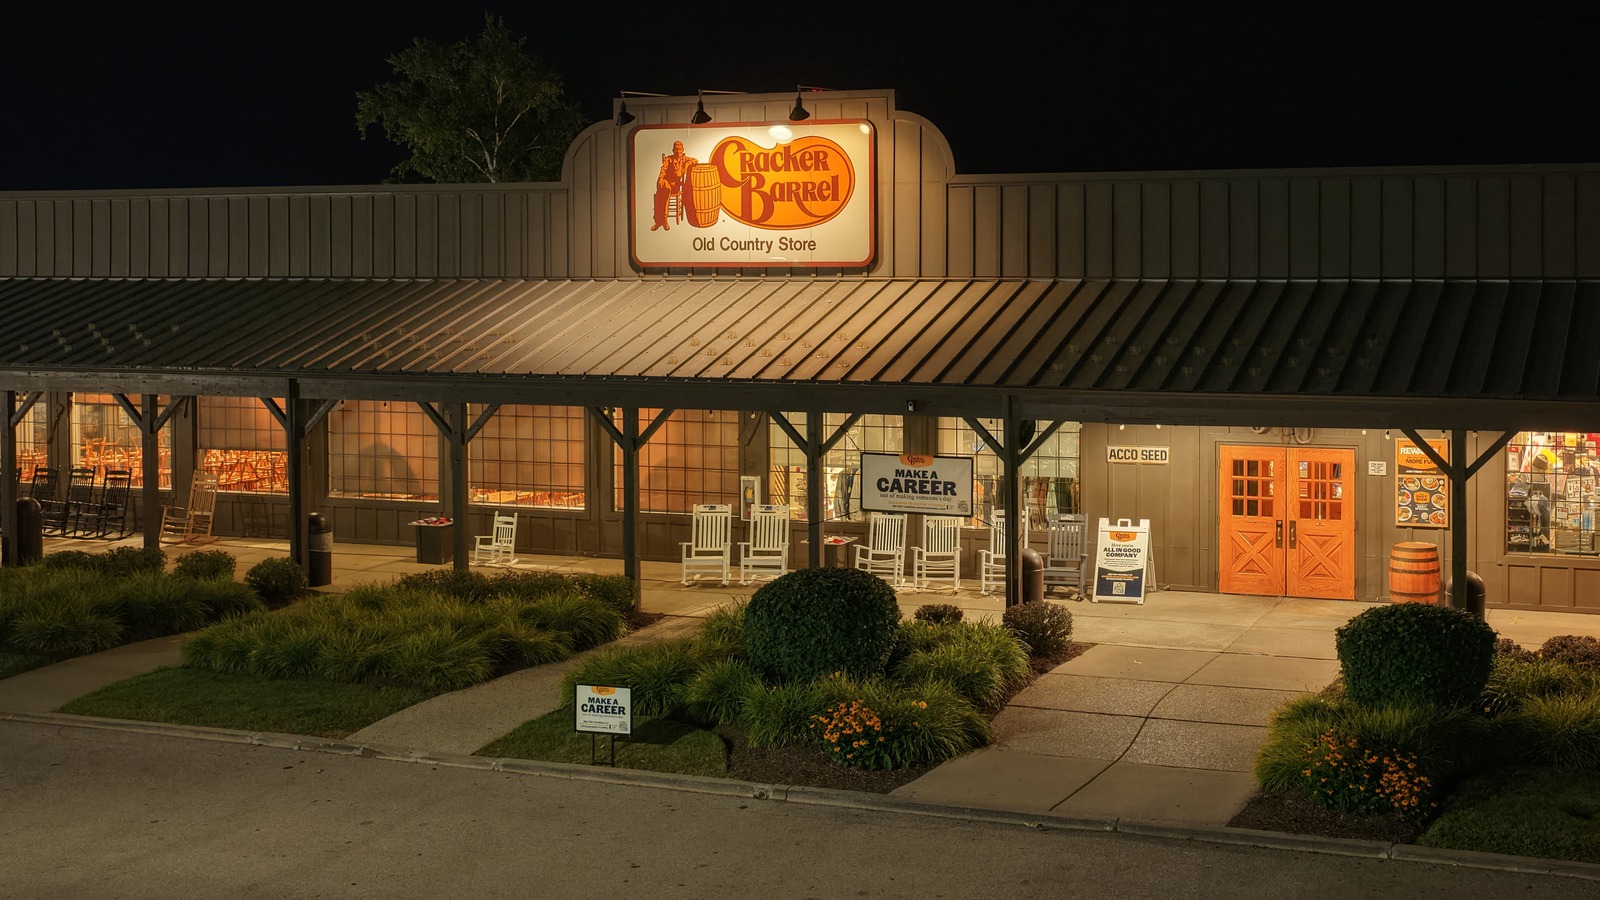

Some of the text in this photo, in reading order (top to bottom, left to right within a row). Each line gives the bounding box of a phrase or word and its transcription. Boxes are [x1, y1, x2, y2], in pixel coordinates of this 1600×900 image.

[711, 140, 831, 188] Cracker
[740, 172, 840, 224] Barrel
[692, 237, 817, 254] Old Country Store
[1109, 449, 1167, 461] ACCO SEED
[895, 469, 938, 480] MAKE A
[876, 477, 957, 496] CAREER
[896, 493, 915, 501] making
[588, 697, 611, 705] MAKE
[581, 703, 626, 715] CAREER
